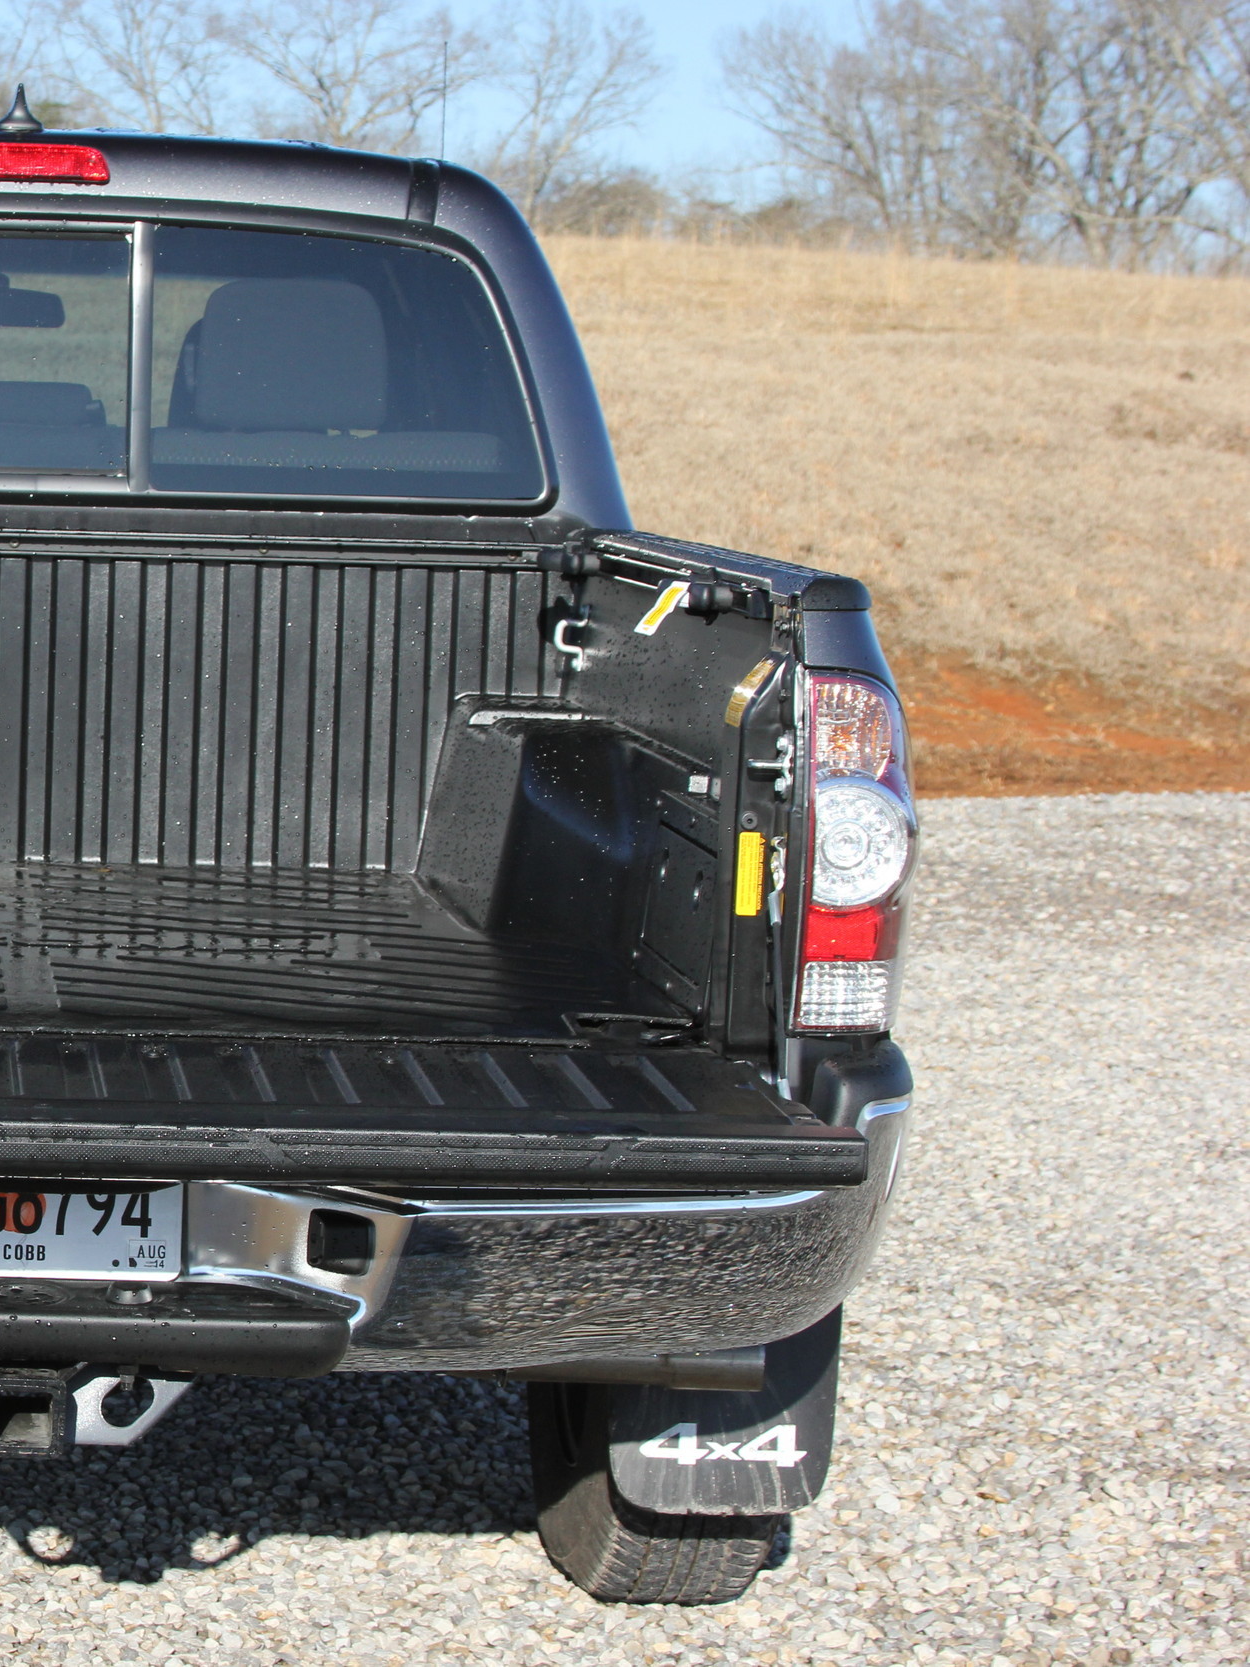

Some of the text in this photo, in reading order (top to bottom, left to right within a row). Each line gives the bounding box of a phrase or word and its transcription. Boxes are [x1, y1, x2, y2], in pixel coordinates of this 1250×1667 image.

[3, 1243, 46, 1262] COBB
[137, 1244, 166, 1259] AUG
[639, 1422, 808, 1468] 4x4
